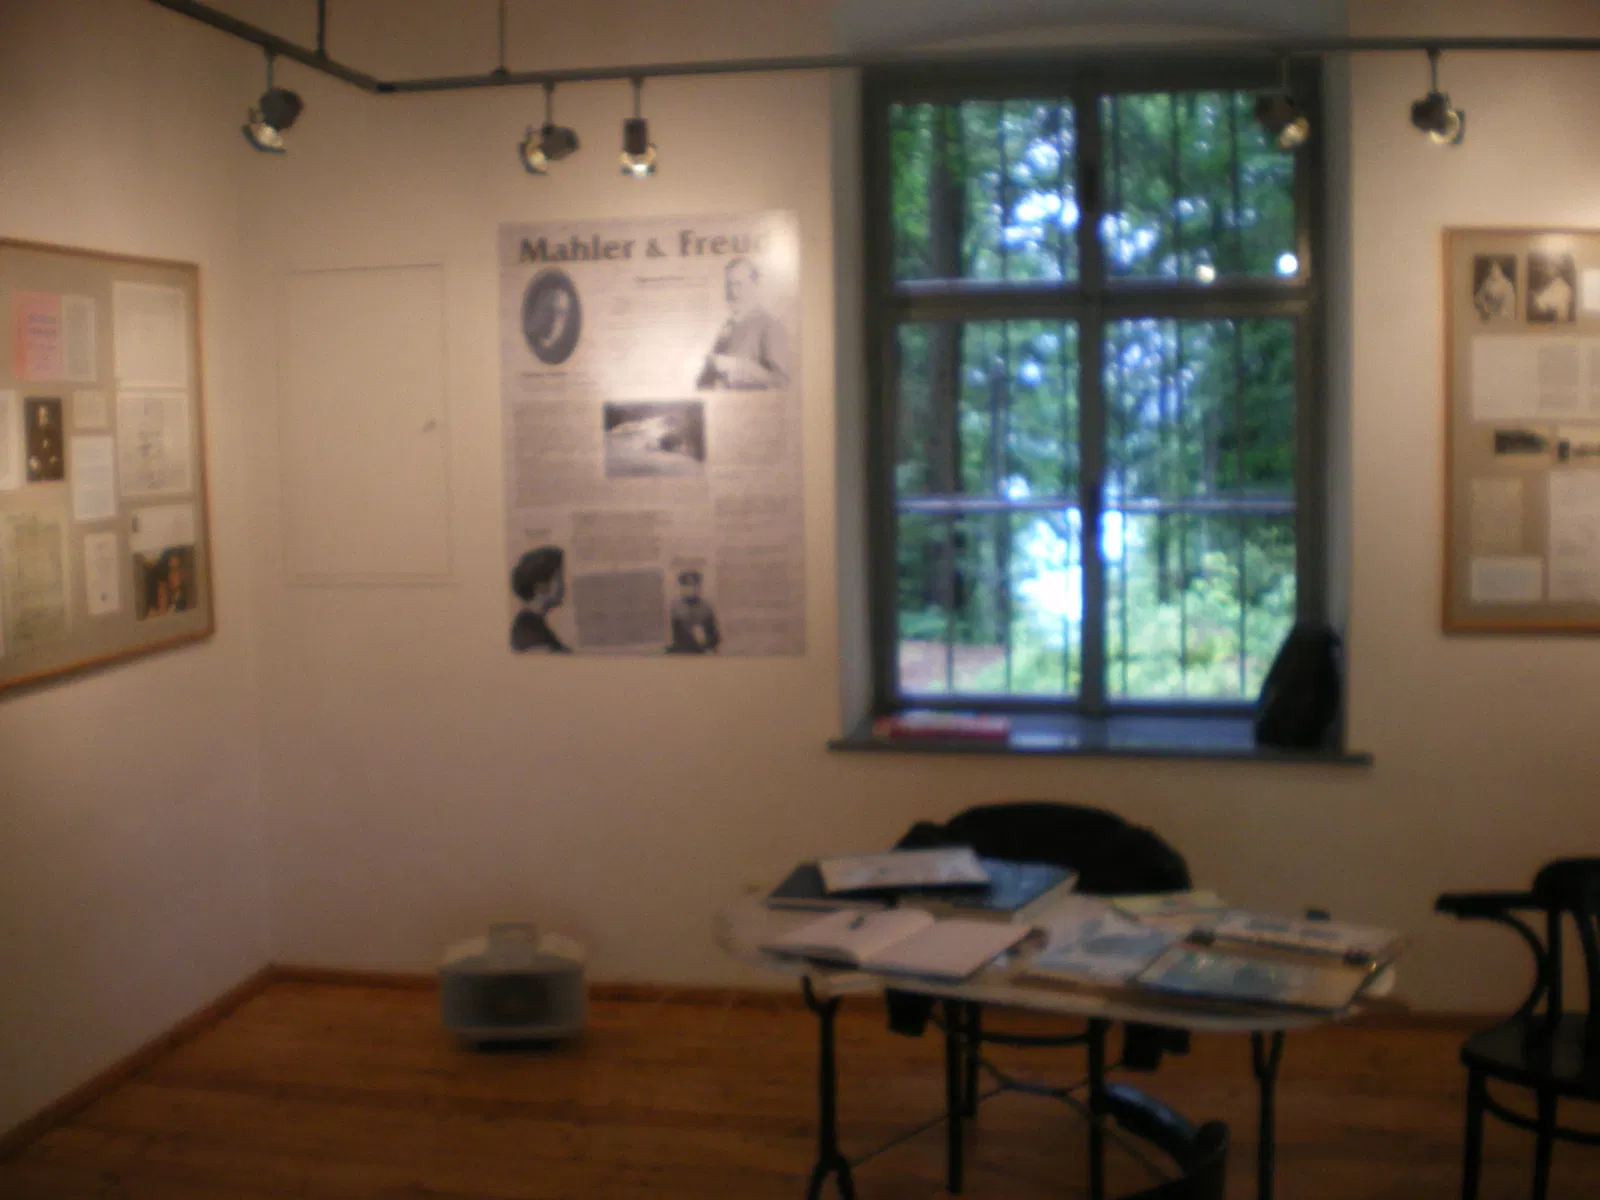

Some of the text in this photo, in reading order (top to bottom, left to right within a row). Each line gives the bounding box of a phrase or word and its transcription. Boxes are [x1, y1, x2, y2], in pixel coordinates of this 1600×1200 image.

[519, 229, 771, 262] Mahler & Freu
